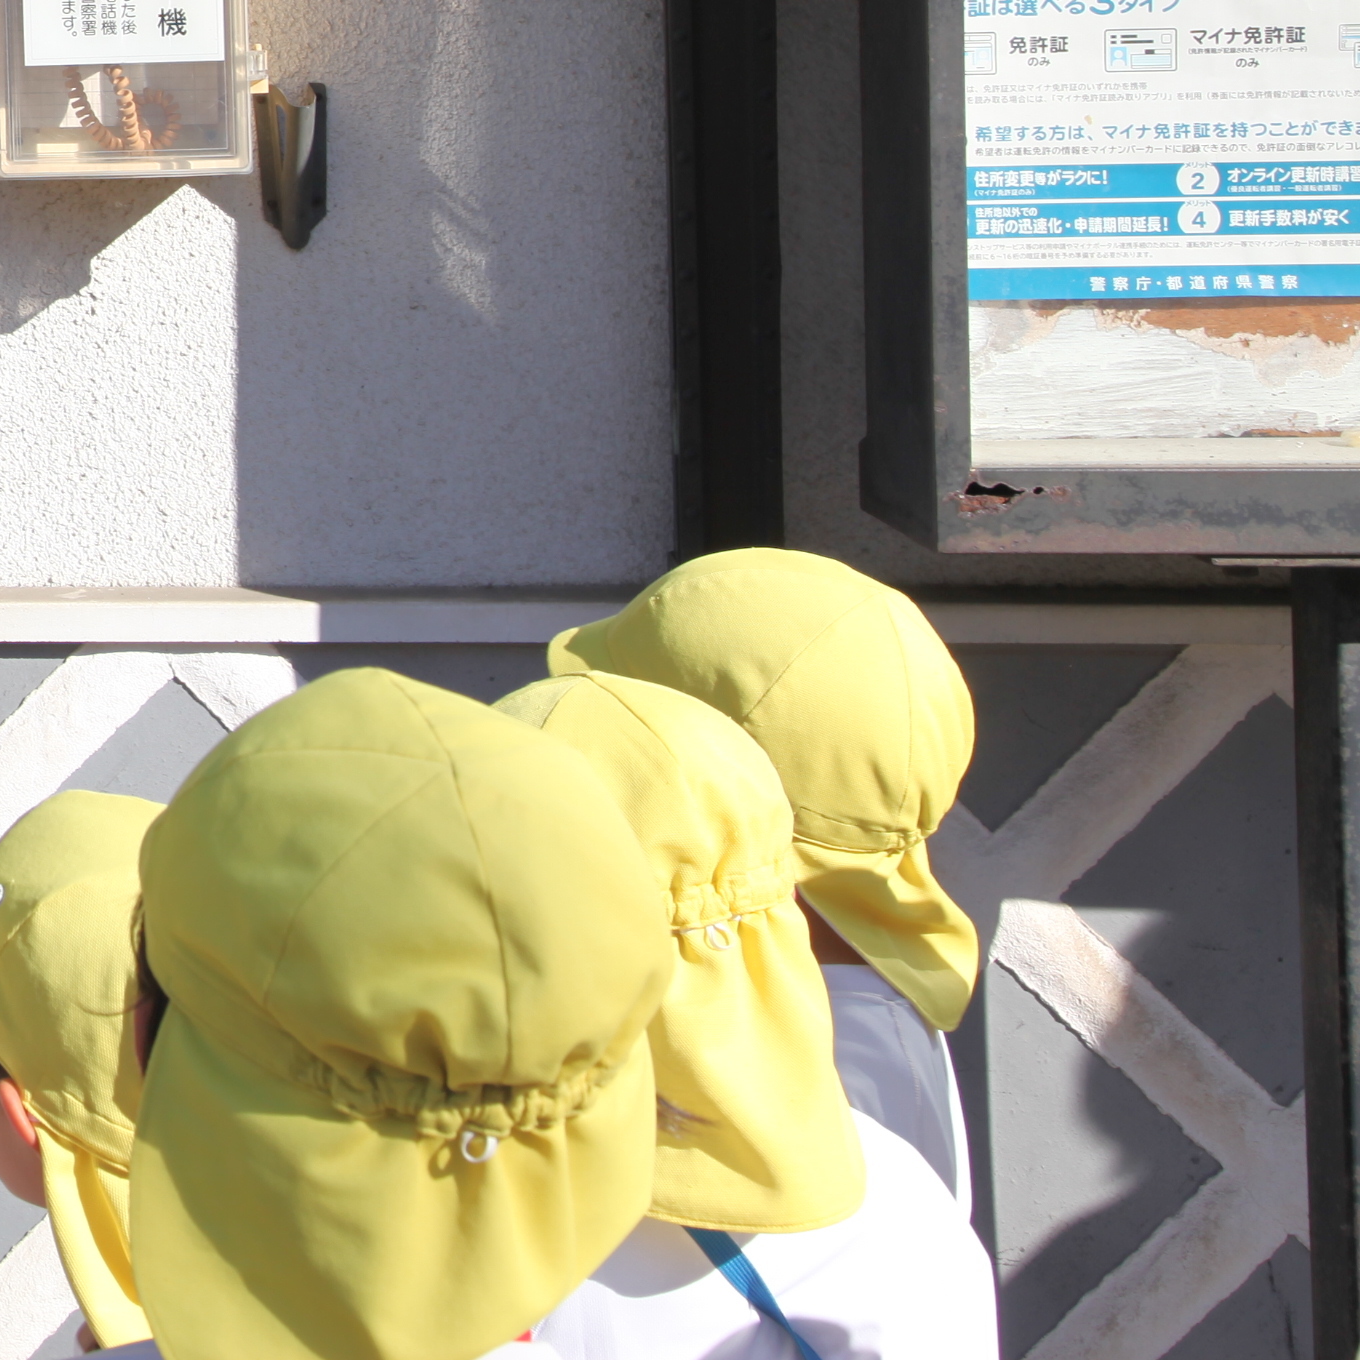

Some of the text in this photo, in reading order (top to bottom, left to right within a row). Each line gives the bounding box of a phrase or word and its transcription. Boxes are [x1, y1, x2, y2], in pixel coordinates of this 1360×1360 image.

[1189, 25, 1307, 46] マイナ免許証
[1008, 35, 1069, 55] 免許証
[1027, 55, 1052, 68] のみ
[1235, 56, 1260, 69] のみ
[1190, 173, 1205, 191] 2
[975, 206, 1038, 218] 住所地以外での
[1191, 211, 1206, 229] 4
[1229, 209, 1350, 228] 更新手数料が安く
[1090, 274, 1299, 291] 警察庁・都道府県警察
